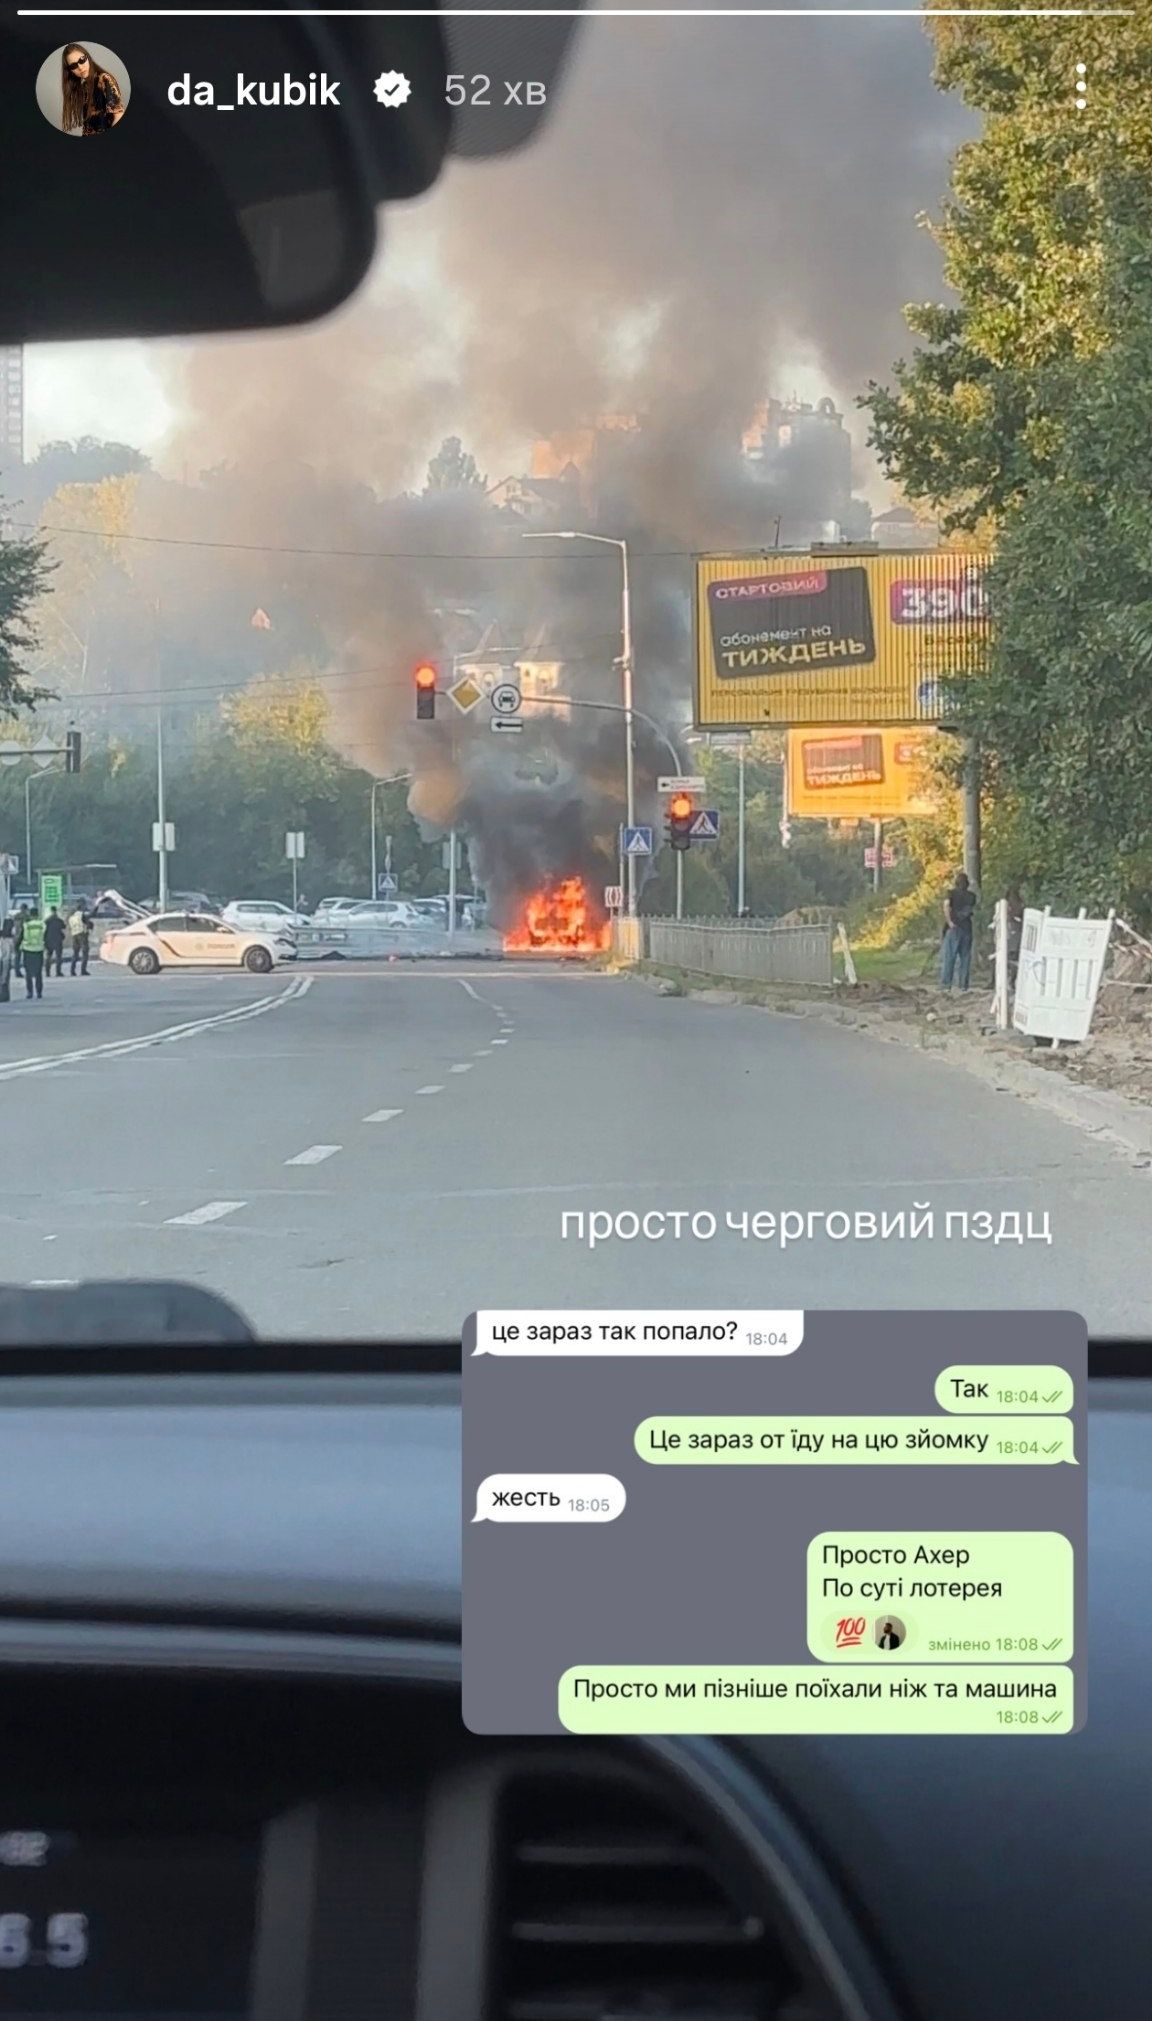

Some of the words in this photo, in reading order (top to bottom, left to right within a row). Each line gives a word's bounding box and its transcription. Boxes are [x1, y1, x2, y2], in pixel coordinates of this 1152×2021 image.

[715, 575, 820, 599] СТАРТОВИЙ
[720, 628, 807, 647] абонемент
[811, 625, 832, 638] на
[722, 638, 866, 668] ТИЖДЕНЬ
